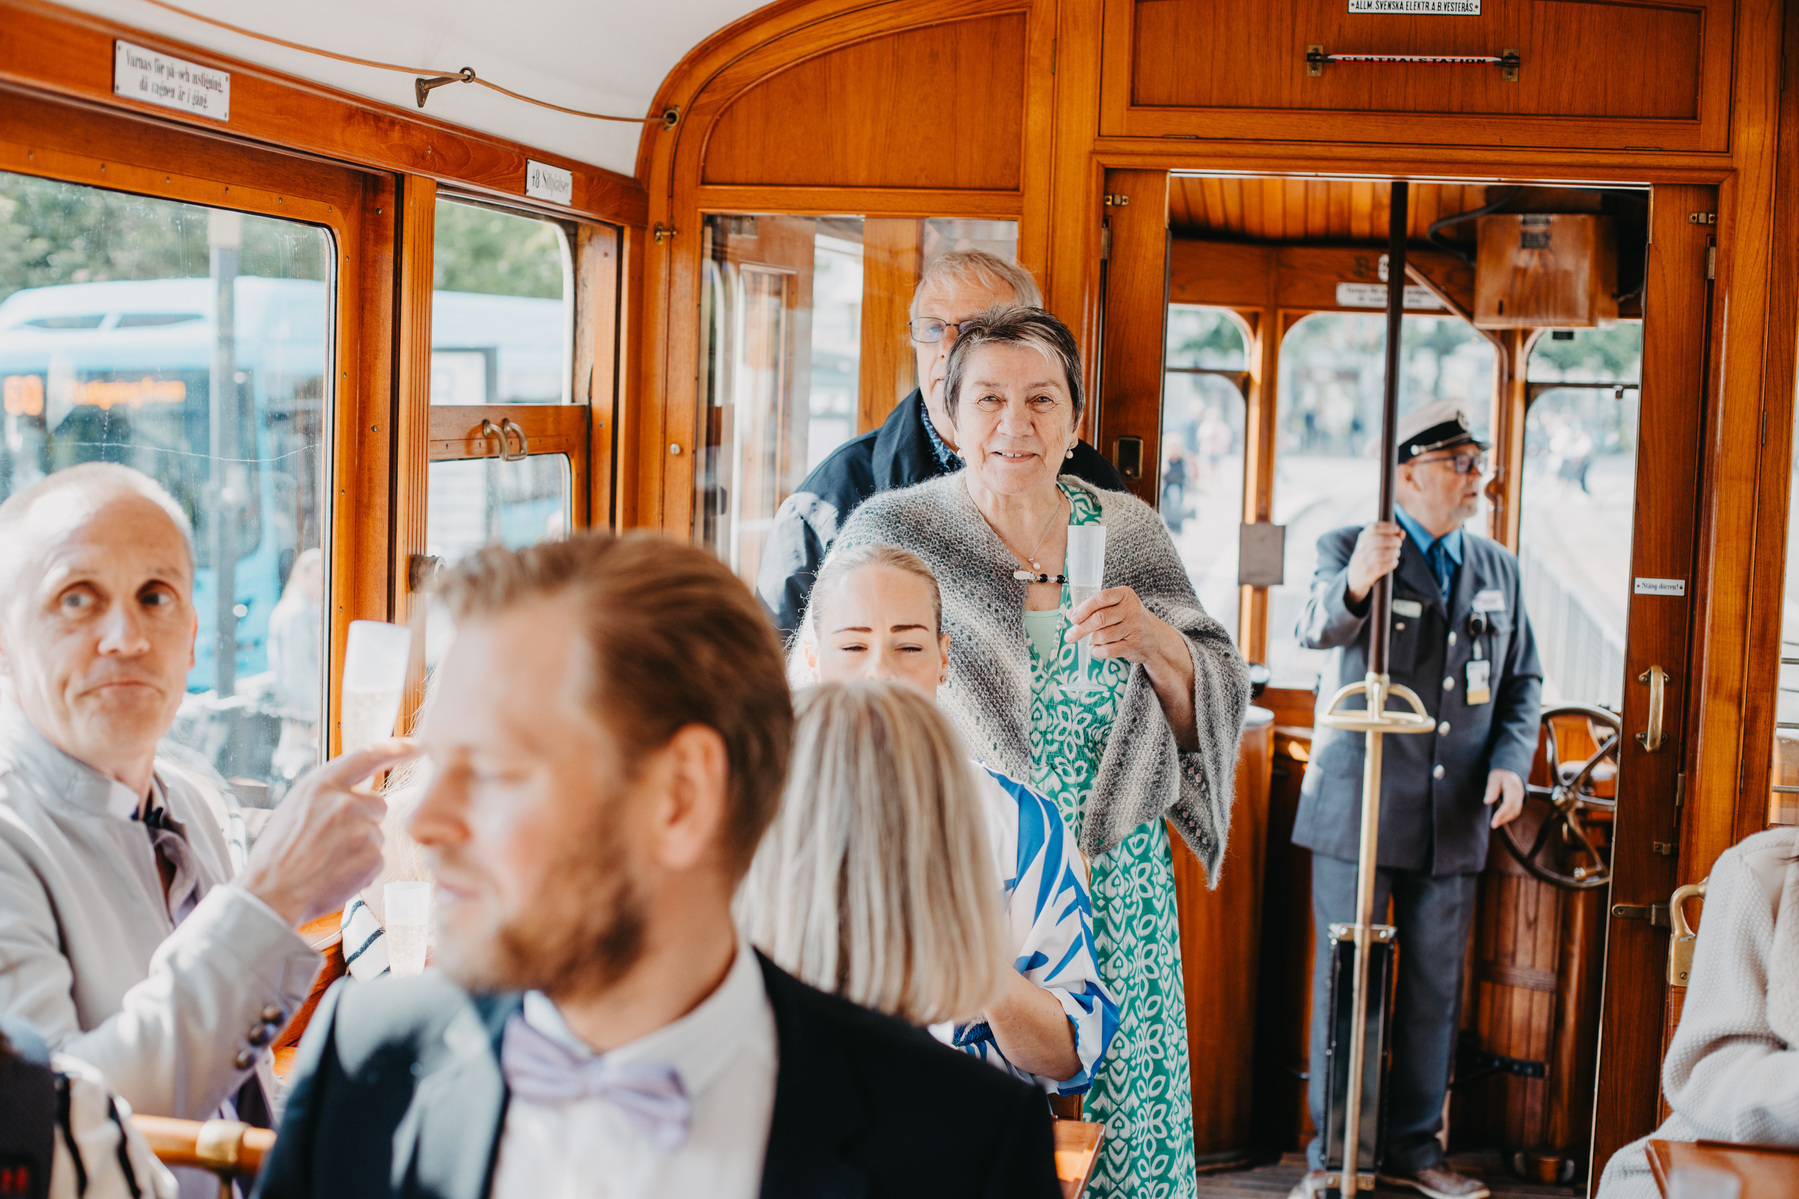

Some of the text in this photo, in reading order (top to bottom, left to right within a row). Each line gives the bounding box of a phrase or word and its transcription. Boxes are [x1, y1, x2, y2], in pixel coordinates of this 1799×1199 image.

[1375, 0, 1404, 10] SVENSKA
[126, 49, 152, 71] Varnas
[154, 57, 165, 75] för
[151, 81, 175, 99] vagnen
[1642, 583, 1657, 591] Stäng
